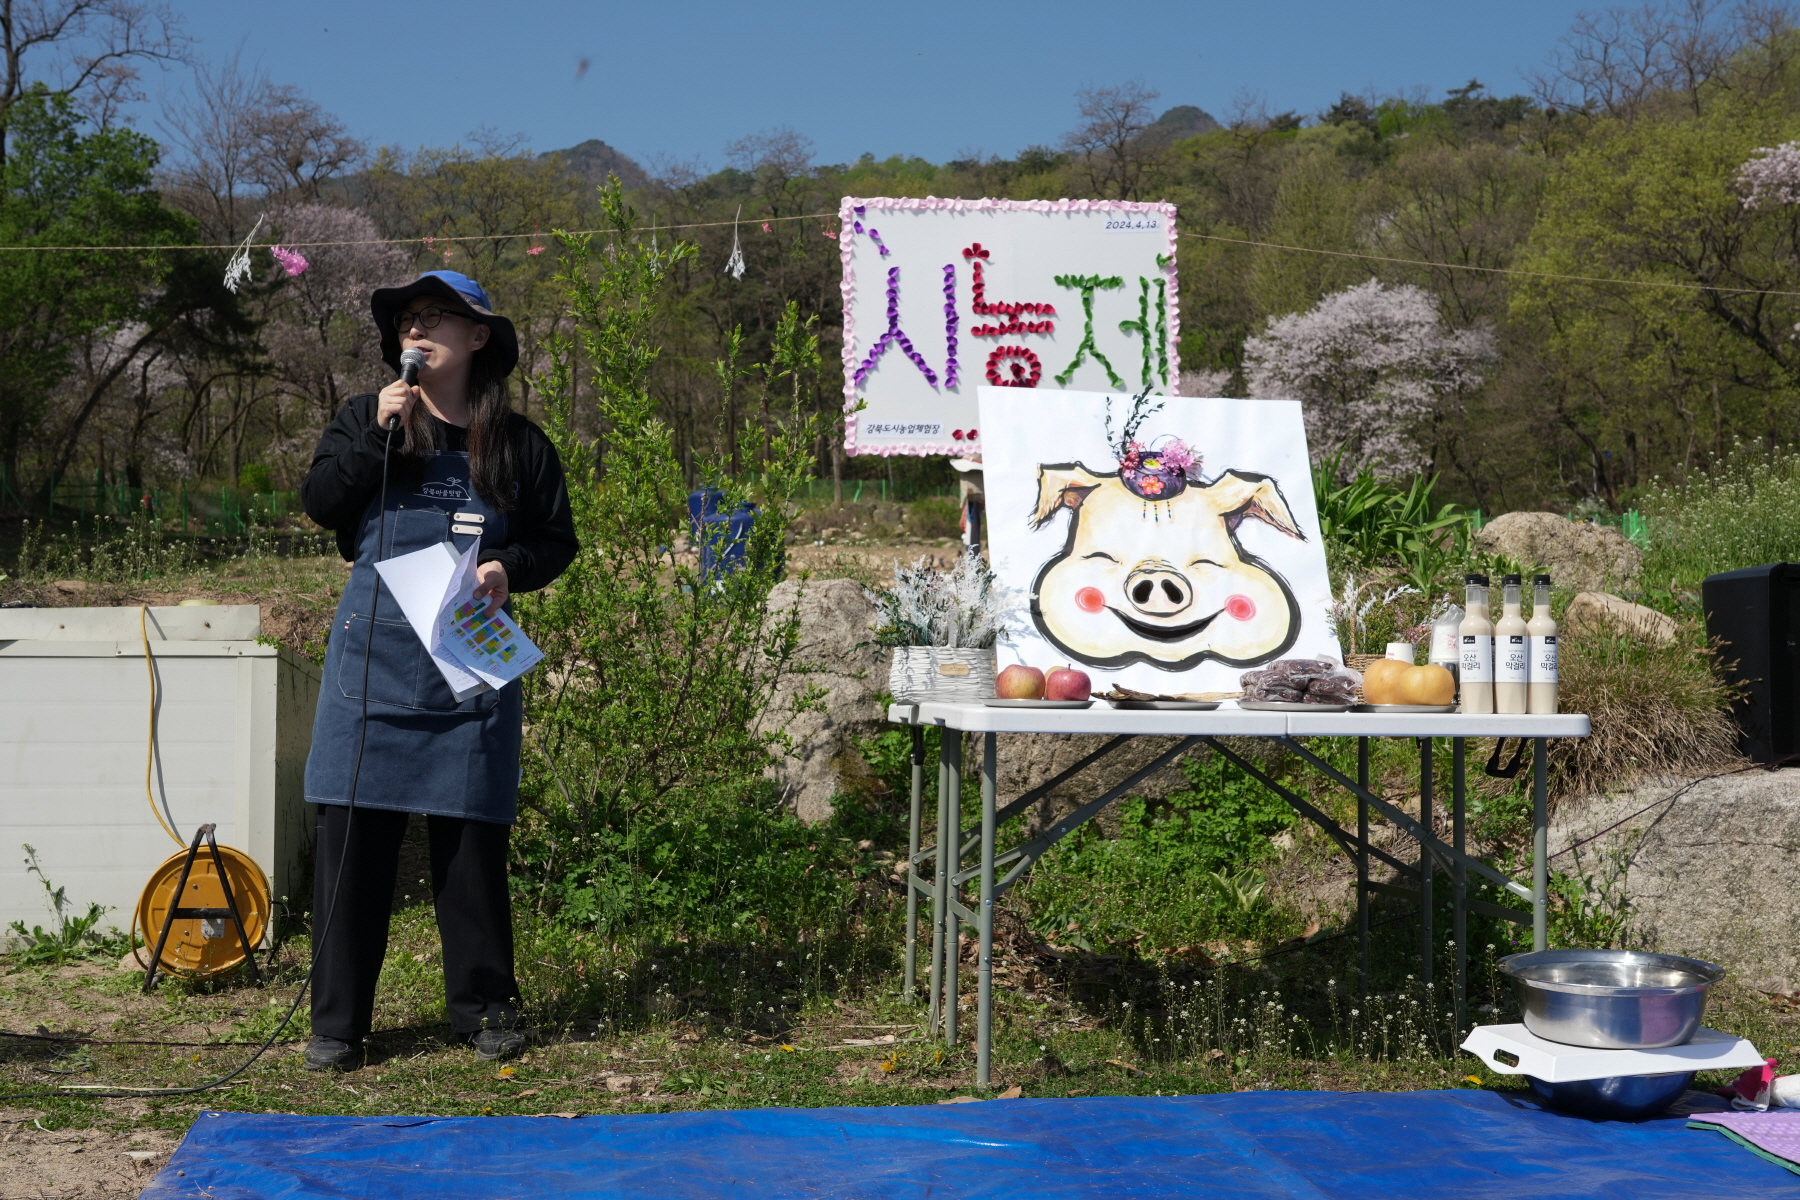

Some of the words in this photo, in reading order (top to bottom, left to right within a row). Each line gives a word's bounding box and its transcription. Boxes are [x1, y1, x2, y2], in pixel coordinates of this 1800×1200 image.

[1105, 220, 1157, 230] 2024.4.13
[852, 252, 1169, 388] 시농제
[866, 423, 941, 435] 강북도시농업체험장
[422, 487, 462, 498] 강북마을텃밭
[1463, 653, 1477, 662] 오산
[1509, 653, 1524, 663] 오산
[1544, 653, 1557, 663] 오산
[1461, 661, 1481, 671] 막걸리
[1505, 661, 1526, 671] 막걸리
